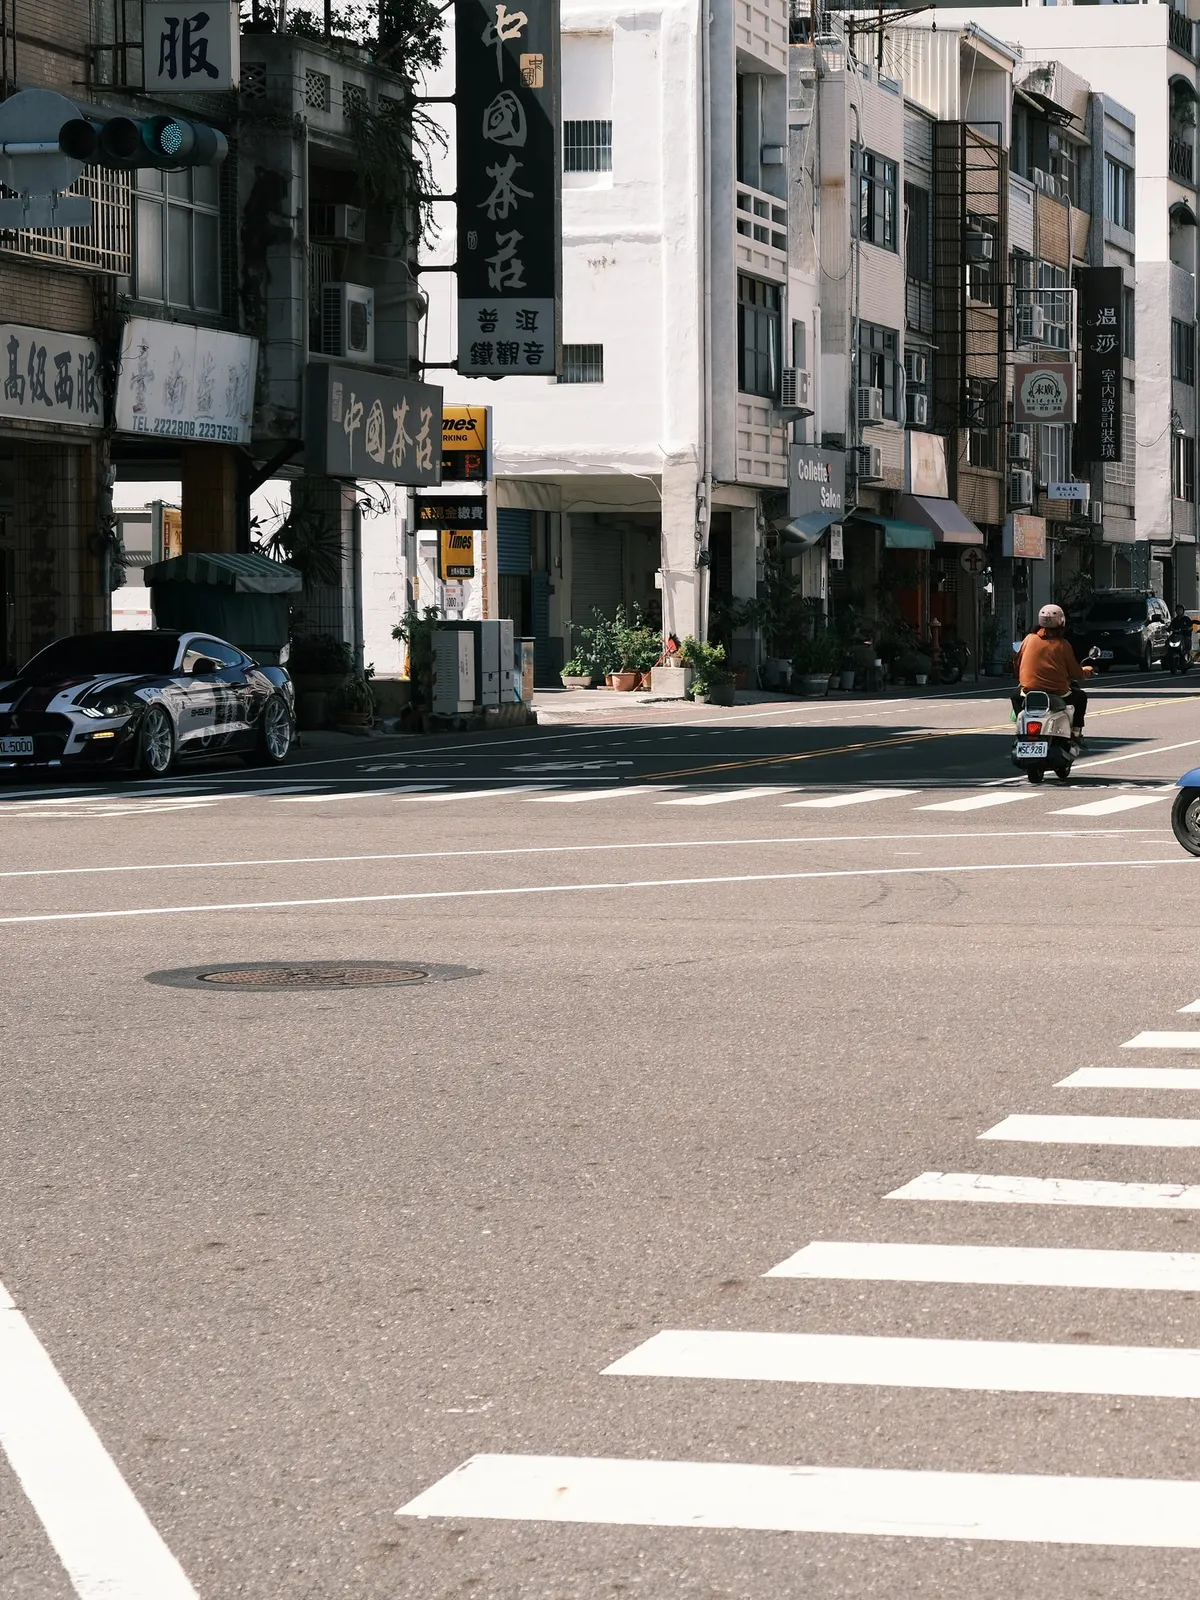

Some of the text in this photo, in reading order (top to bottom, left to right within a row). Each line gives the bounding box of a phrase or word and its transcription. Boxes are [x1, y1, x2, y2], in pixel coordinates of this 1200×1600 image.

[158, 12, 219, 80] 服
[470, 341, 545, 366] 鐵觀音
[798, 458, 828, 483] Collette
[820, 486, 841, 509] Salon
[448, 531, 472, 549] Times
[191, 706, 214, 718] SHELBY
